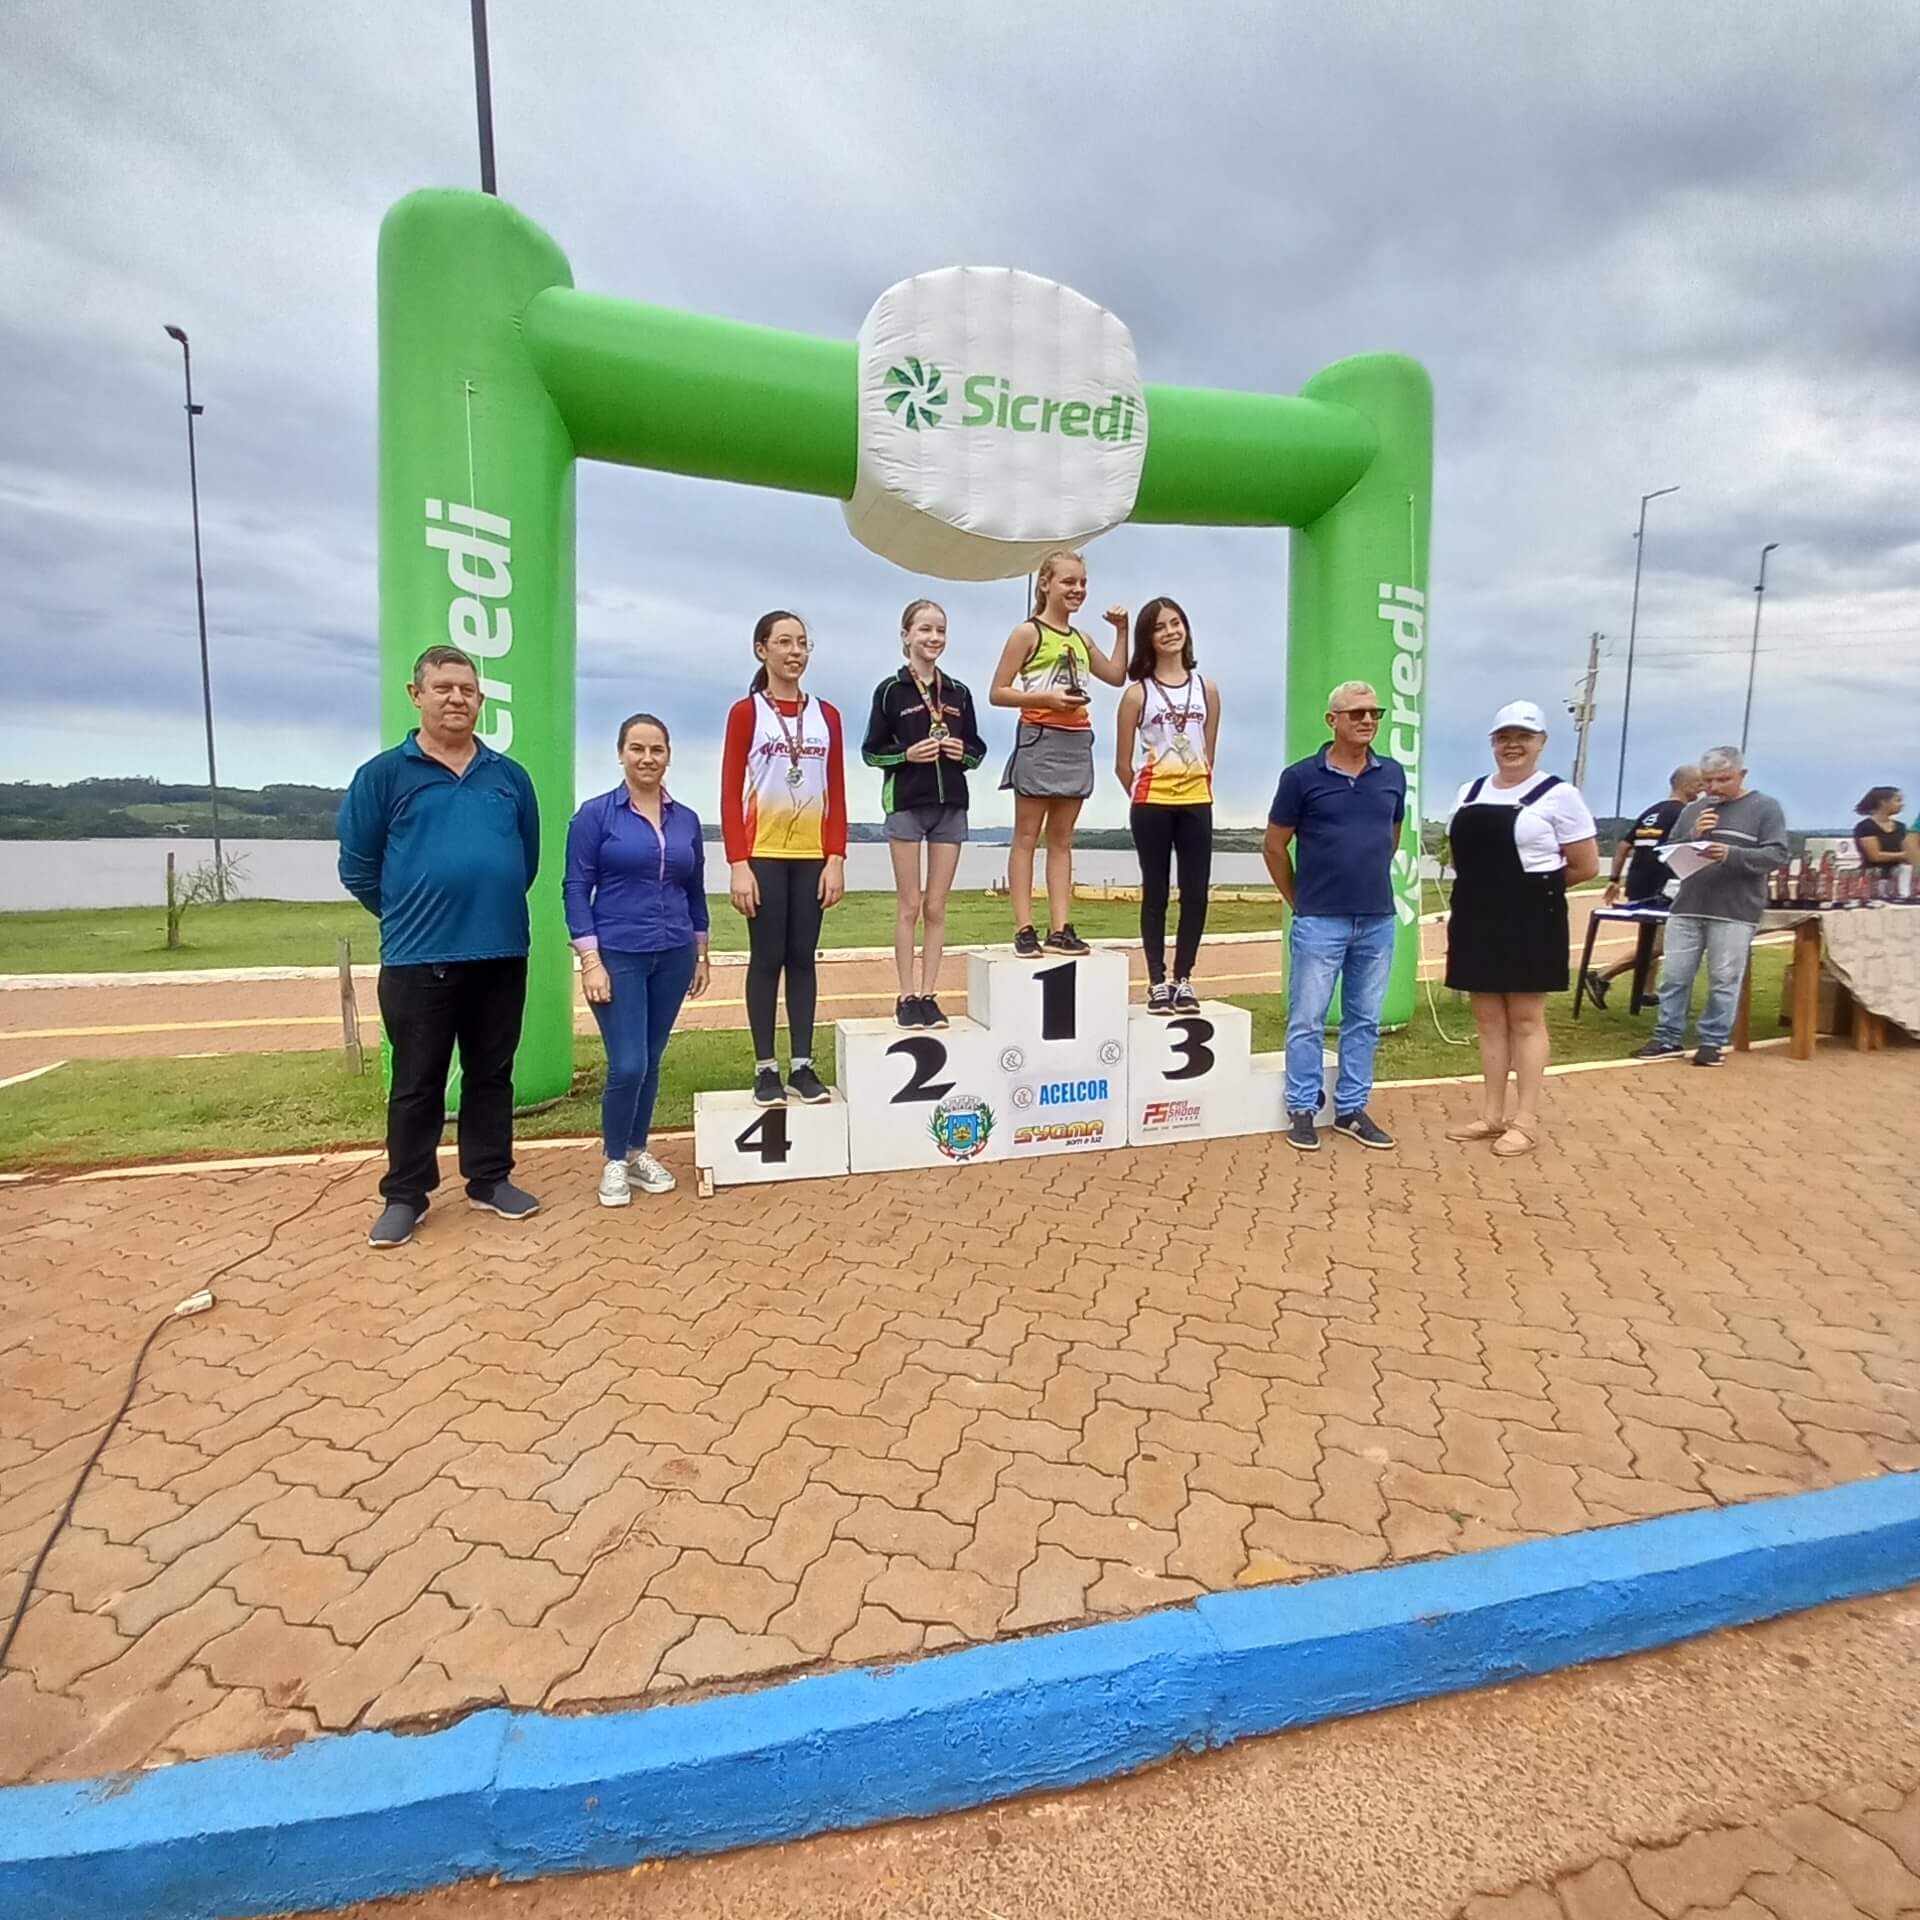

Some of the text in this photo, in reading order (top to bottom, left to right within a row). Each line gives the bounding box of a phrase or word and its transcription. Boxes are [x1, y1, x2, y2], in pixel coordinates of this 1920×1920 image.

[961, 375, 1136, 442] Sicredi
[1032, 960, 1077, 1040] 1
[885, 1036, 957, 1104] 2
[1162, 1017, 1215, 1081] 3
[1039, 1079, 1109, 1106] ACELCOR
[734, 1108, 792, 1164] 4
